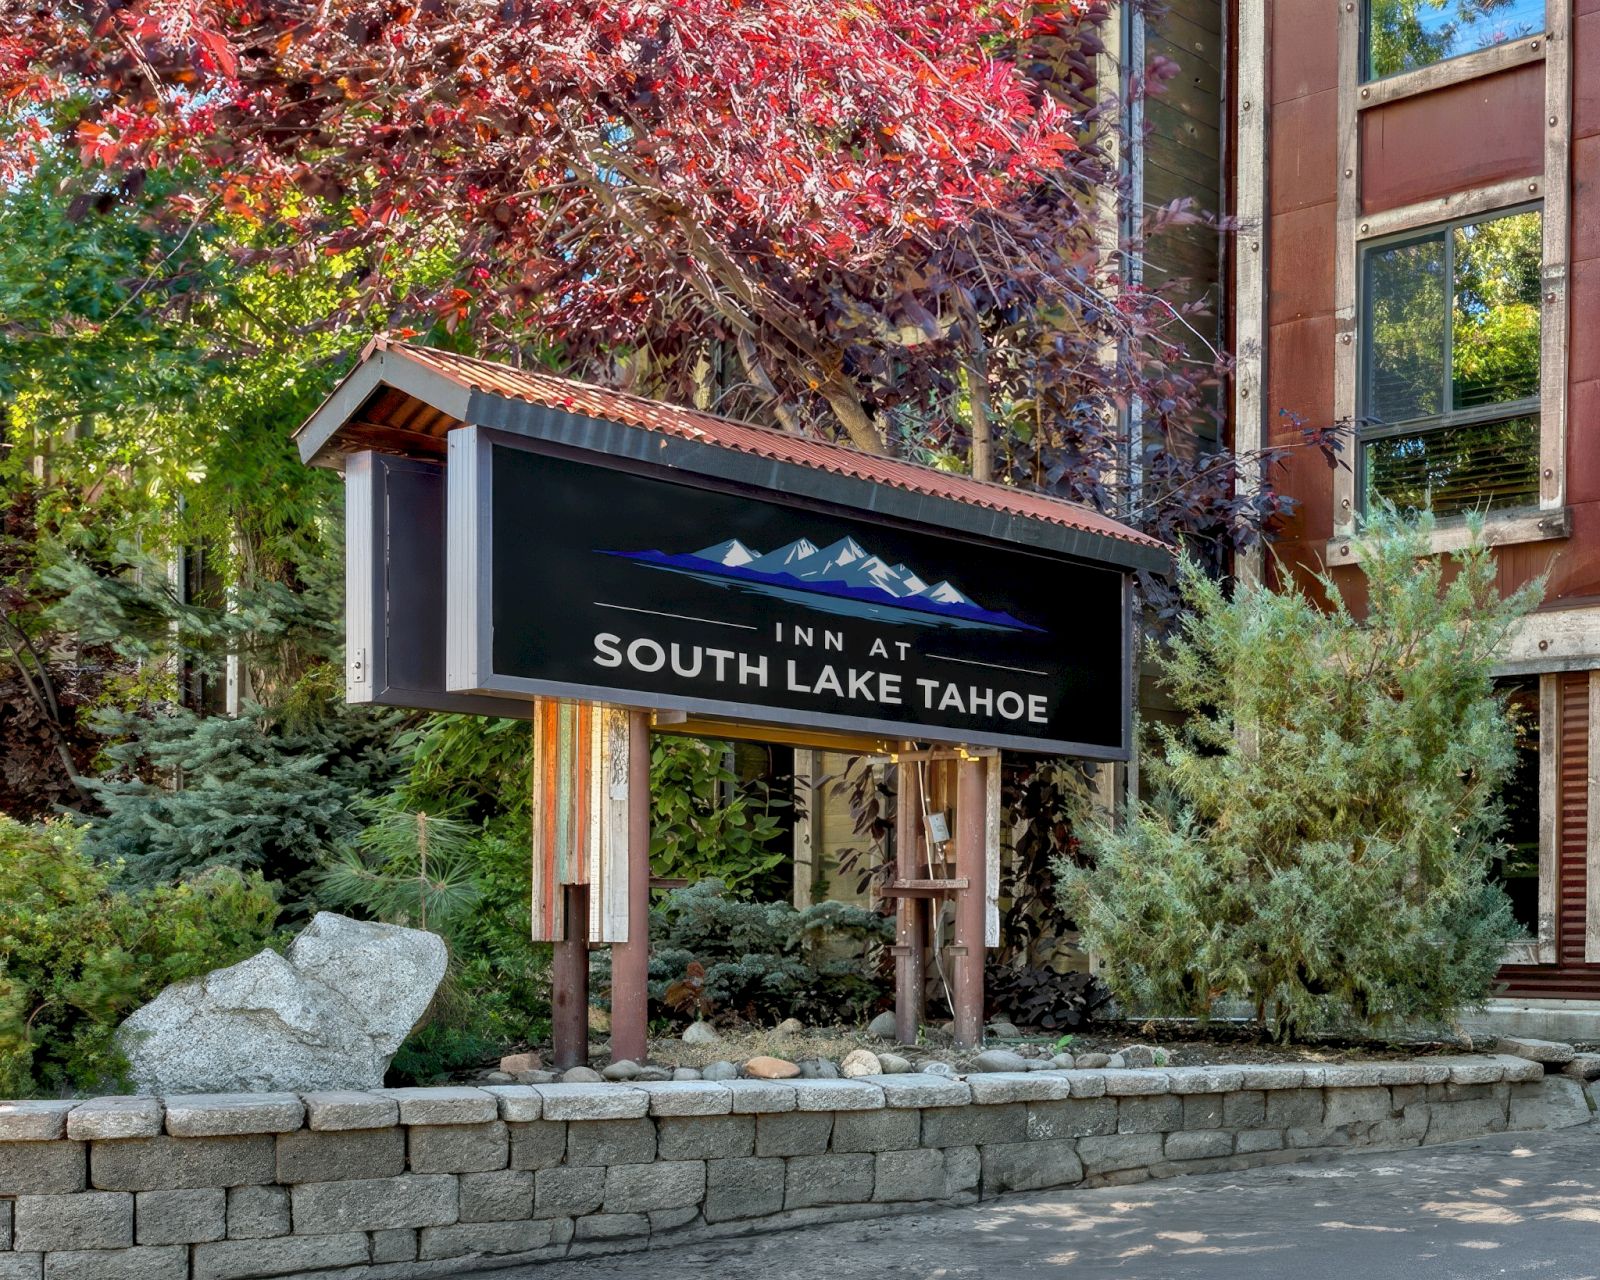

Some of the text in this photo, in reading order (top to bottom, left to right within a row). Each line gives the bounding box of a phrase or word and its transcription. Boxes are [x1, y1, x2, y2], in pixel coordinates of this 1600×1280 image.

[775, 621, 911, 662] INN AT
[592, 631, 1049, 724] SOUTH LAKE TAHOE
